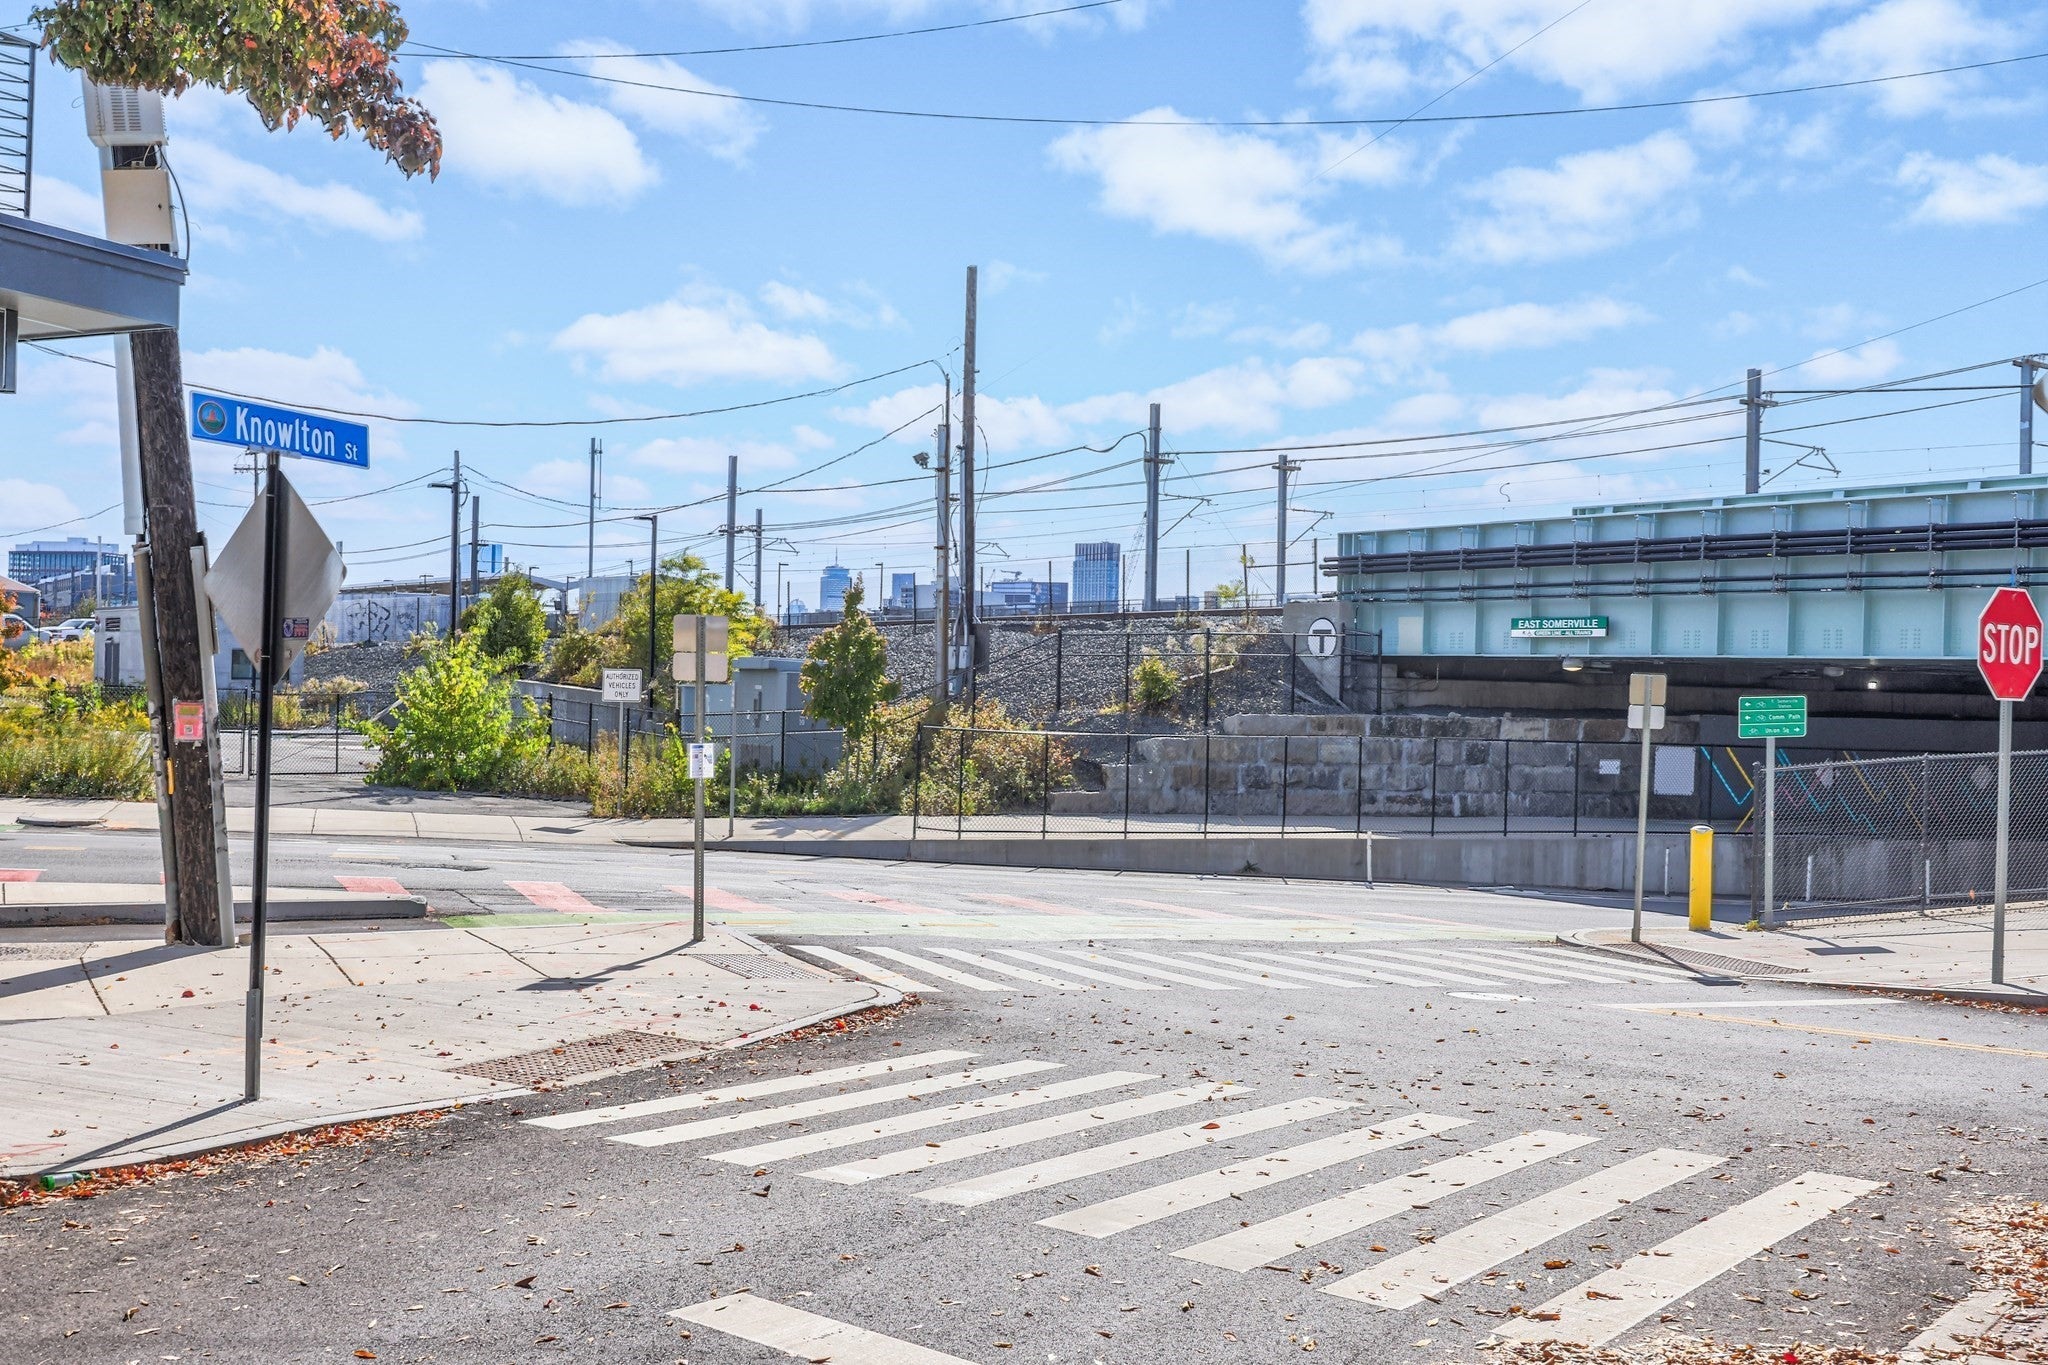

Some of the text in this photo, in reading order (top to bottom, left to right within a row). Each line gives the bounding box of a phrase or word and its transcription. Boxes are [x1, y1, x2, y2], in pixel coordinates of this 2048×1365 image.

[236, 405, 358, 461] Knowlton St
[1518, 619, 1598, 629] EAST SOMERVILLE
[1312, 629, 1331, 653] T
[1983, 623, 2039, 665] STOP
[606, 673, 639, 681] AUTHORIZED
